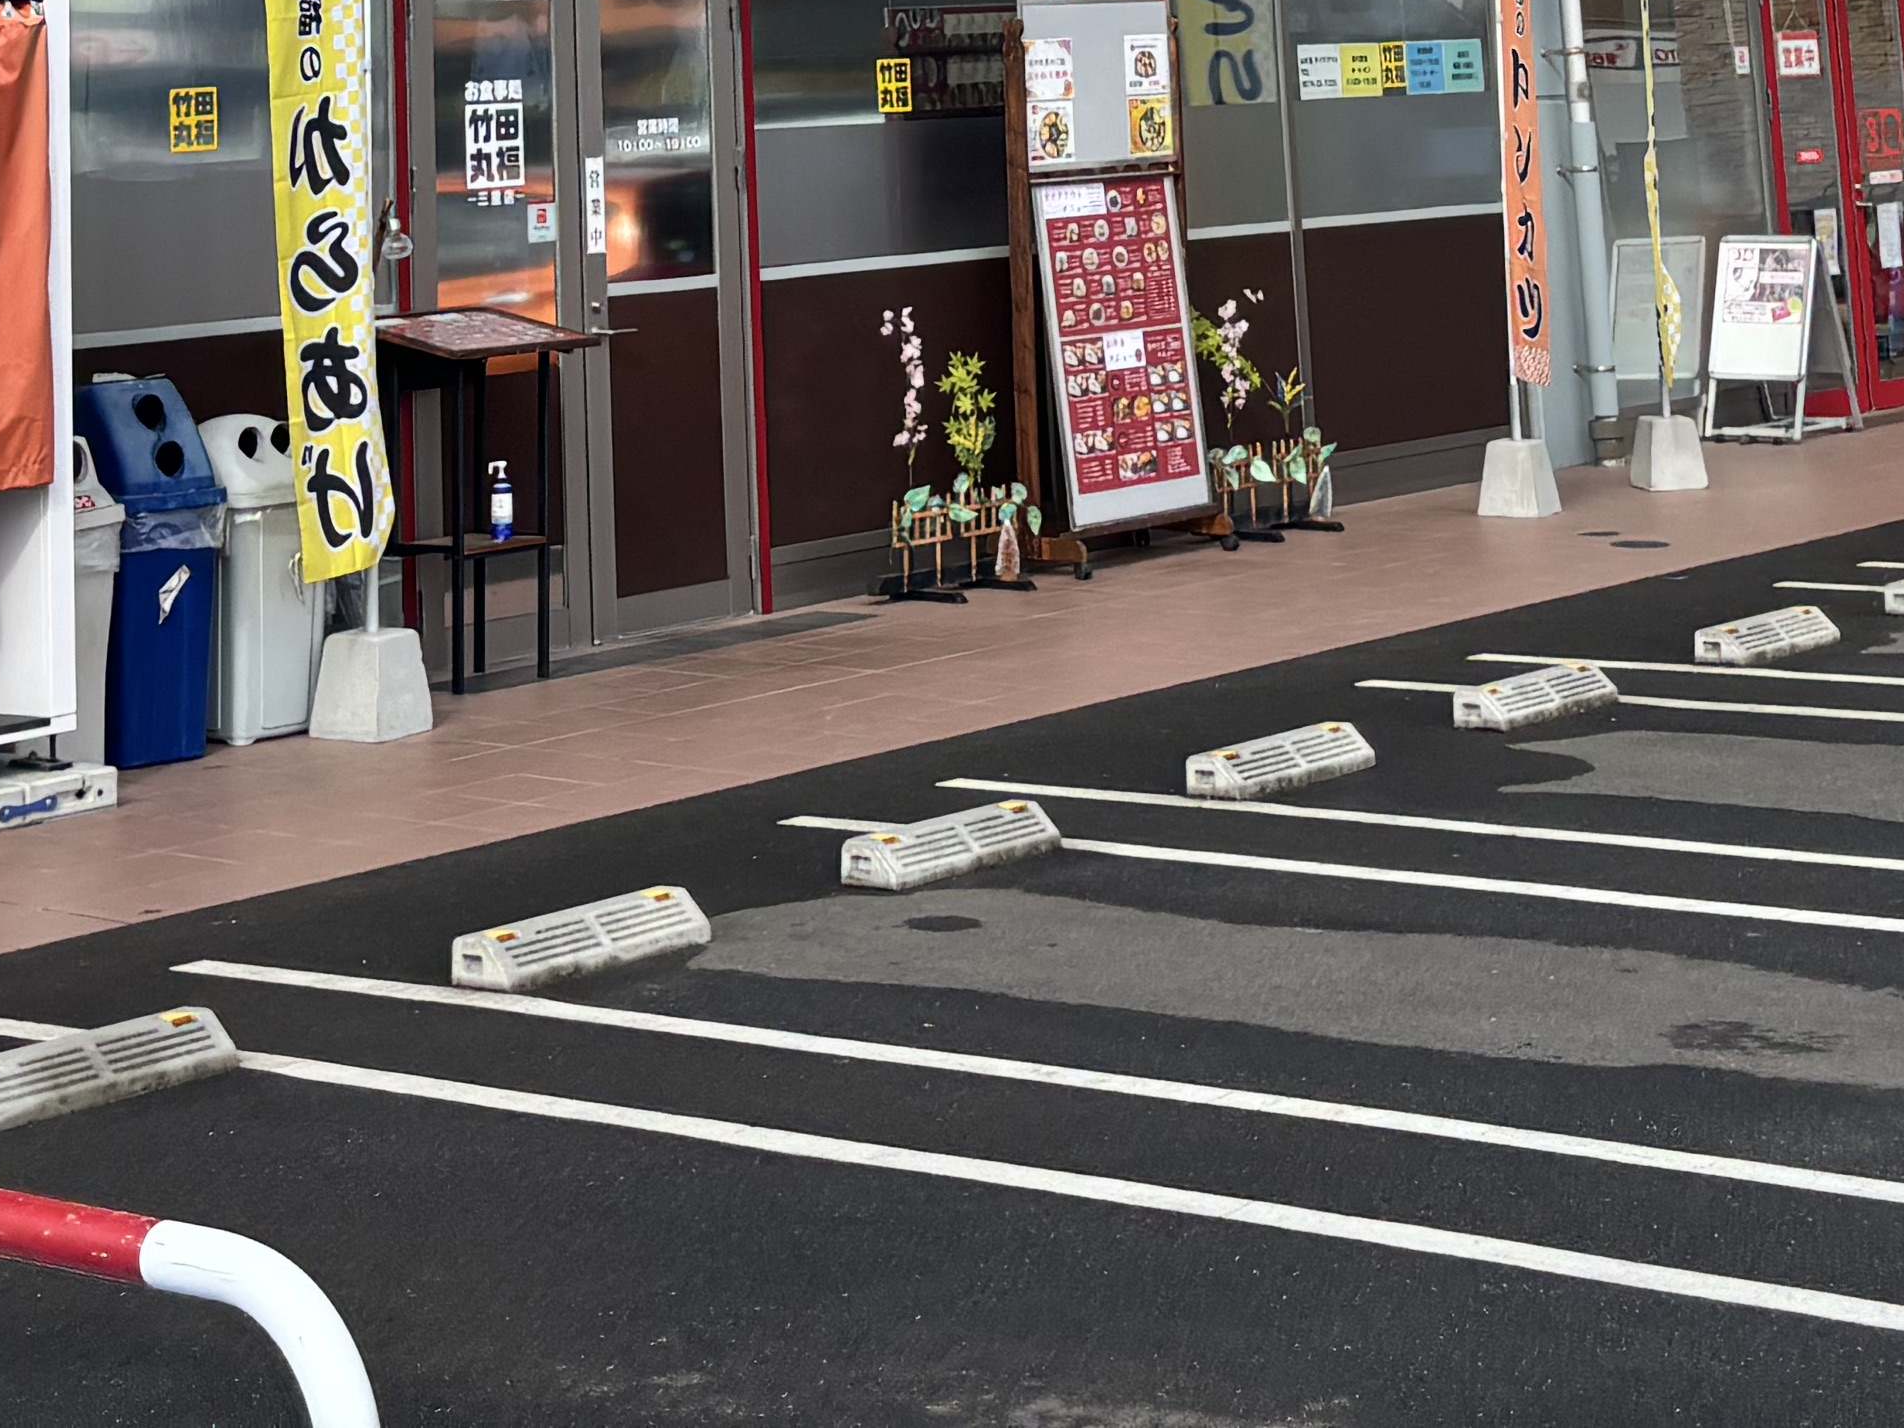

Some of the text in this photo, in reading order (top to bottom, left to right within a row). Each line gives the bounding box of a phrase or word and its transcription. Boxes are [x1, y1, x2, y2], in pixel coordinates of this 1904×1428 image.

[879, 62, 908, 85] 竹田
[173, 90, 216, 118] 竹田
[880, 86, 909, 109] 丸福
[173, 121, 216, 149] 丸福
[468, 107, 520, 144] 竹田
[469, 146, 521, 184] 丸福
